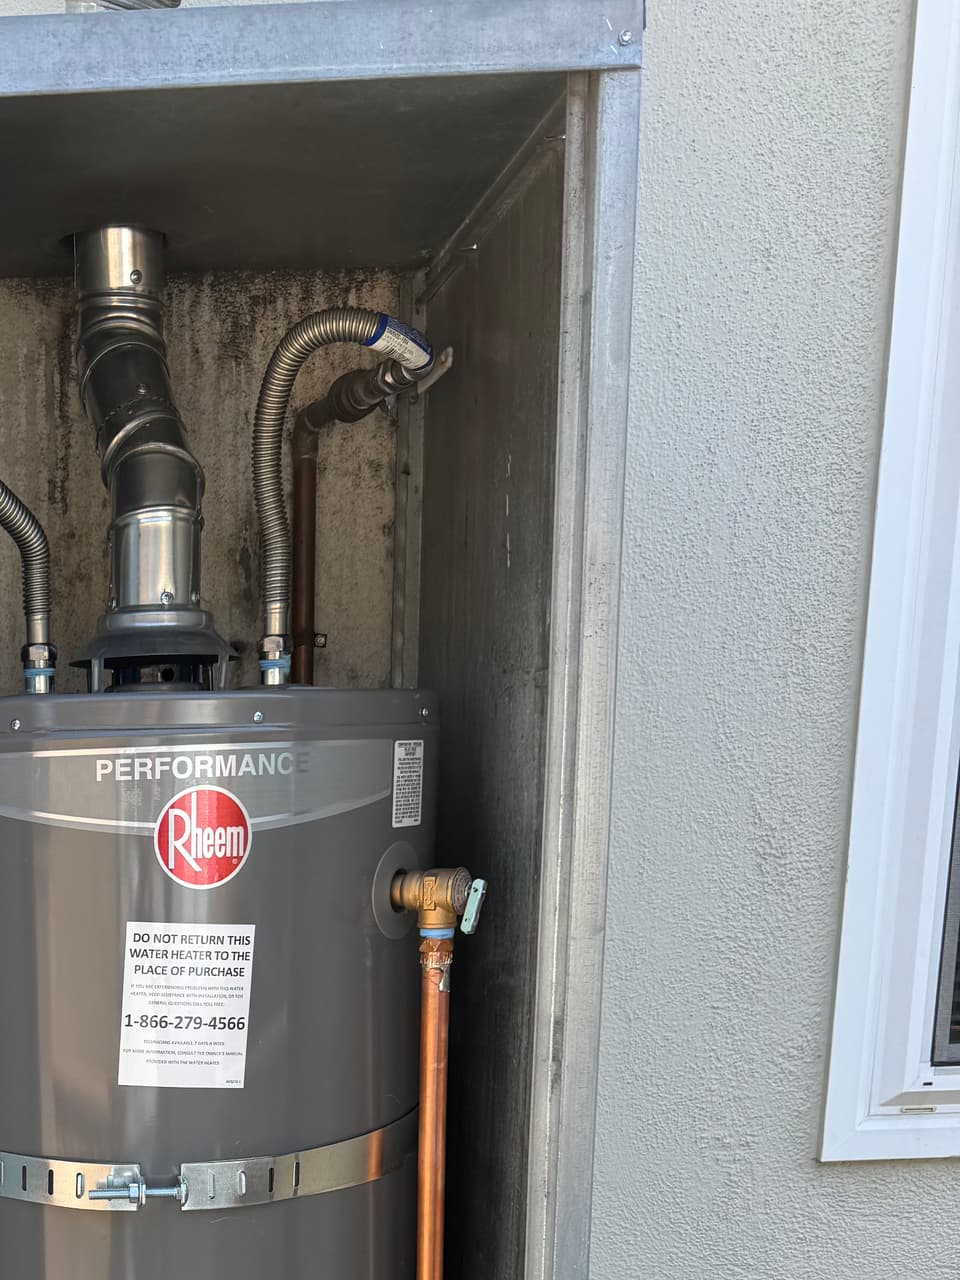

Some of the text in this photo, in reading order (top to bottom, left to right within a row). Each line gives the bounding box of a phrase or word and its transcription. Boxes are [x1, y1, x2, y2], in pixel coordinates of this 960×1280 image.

[96, 752, 309, 781] PERFORMANCE
[169, 791, 244, 872] Rheem
[133, 933, 251, 945] DO NOT RETURN THIS
[129, 948, 250, 961] WATER HEATER TO THE
[134, 964, 245, 977] PLACE OF PURCHASE
[125, 1013, 245, 1030] 1-866-279-4566
